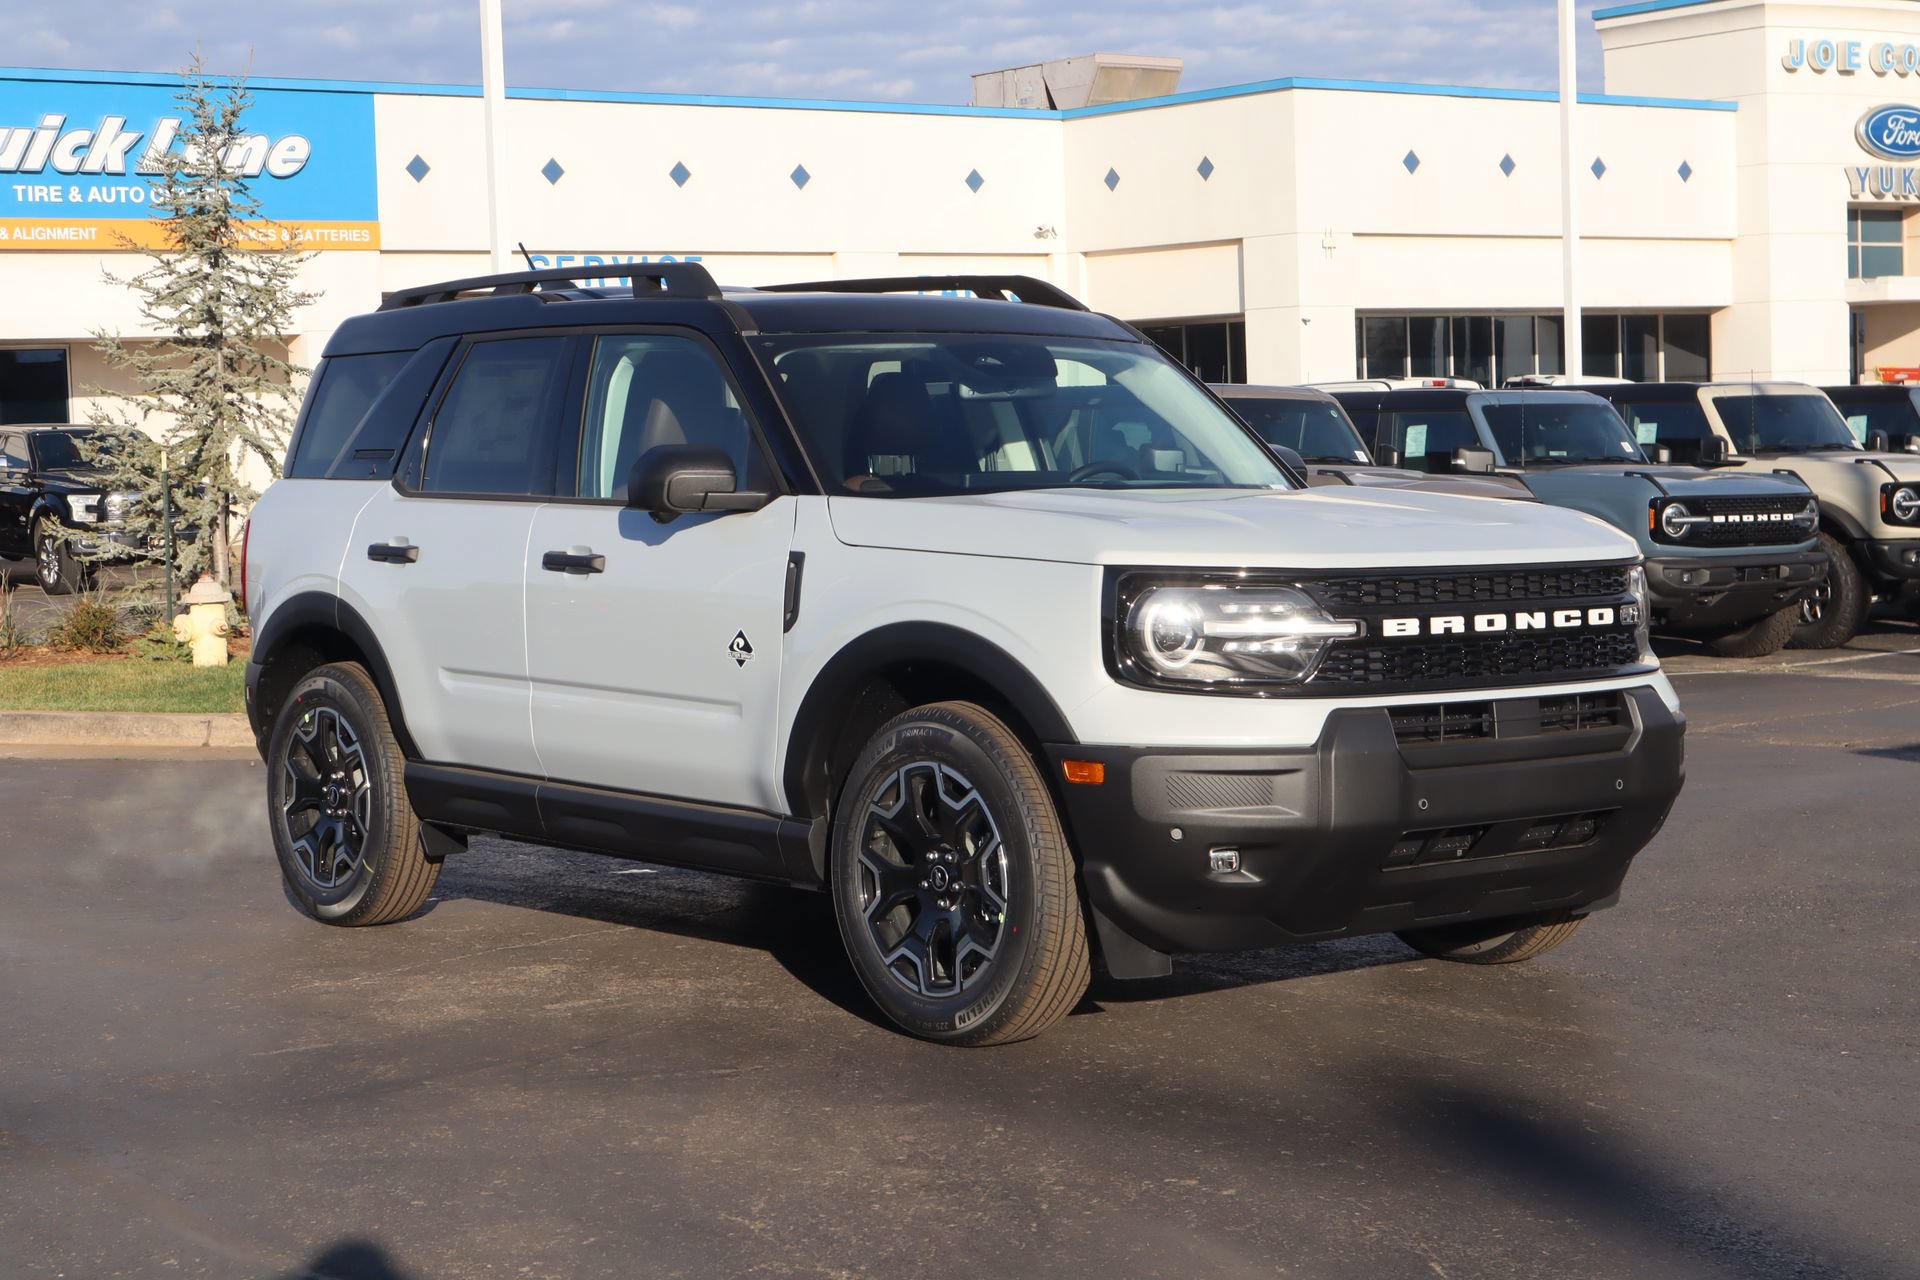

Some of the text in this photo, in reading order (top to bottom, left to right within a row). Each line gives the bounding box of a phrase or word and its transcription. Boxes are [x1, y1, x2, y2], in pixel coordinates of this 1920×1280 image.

[1783, 39, 1920, 76] JOE CO
[12, 185, 64, 202] TIRE
[68, 186, 83, 202] &
[88, 186, 146, 203] AUTO
[1846, 167, 1920, 197] YUK
[13, 227, 98, 240] ALIGNMENT
[223, 229, 277, 241] AKES
[281, 229, 289, 241] &
[1712, 513, 1794, 523] BRONCO
[1382, 607, 1614, 637] BRONCO
